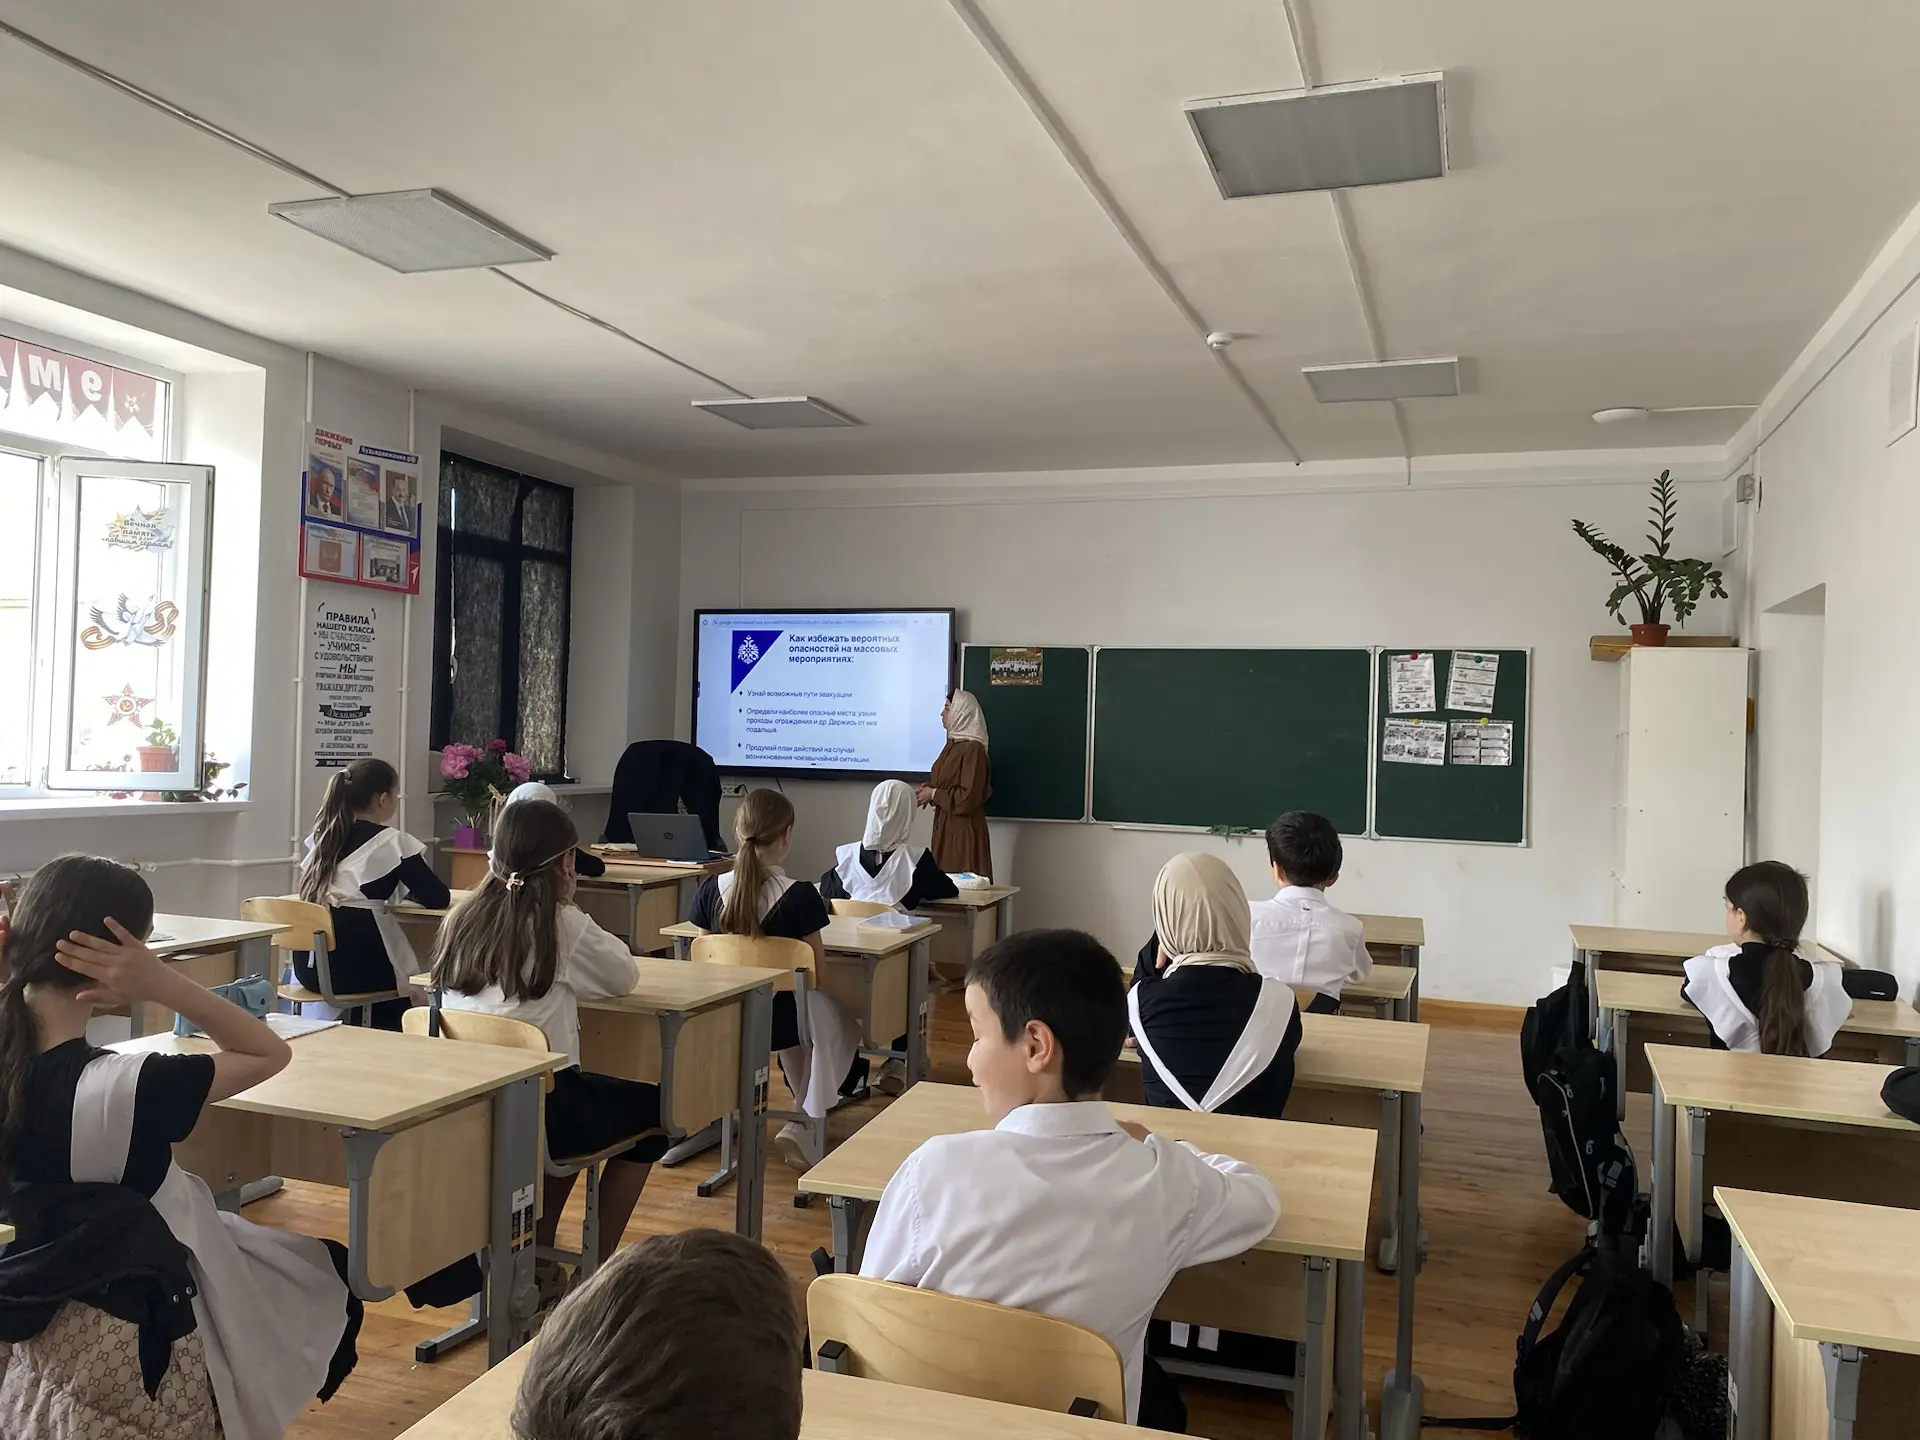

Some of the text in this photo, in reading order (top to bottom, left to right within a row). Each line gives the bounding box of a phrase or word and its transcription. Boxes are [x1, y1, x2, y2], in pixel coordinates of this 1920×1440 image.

[315, 437, 342, 451] ПЕРВЫХ
[124, 518, 156, 529] Вечная
[122, 529, 156, 537] память
[326, 612, 370, 625] ПРАВИЛА
[316, 622, 375, 634] НАШЕГО КЛАССА
[318, 630, 329, 639] МЫ
[789, 634, 900, 644] Как избежать вероятных
[327, 641, 360, 652] УЧИМСЯ
[789, 644, 840, 653] опасностей
[319, 652, 374, 663] УДОВОЛЬСТВИЕМ
[789, 655, 855, 664] мероприятиях:
[339, 663, 357, 674] МЫ
[747, 690, 766, 698] Узнай
[767, 690, 803, 698] возможные
[803, 691, 817, 699] пути
[746, 708, 778, 716] Определи
[828, 718, 857, 726] Держись
[745, 744, 777, 752] Продумай
[793, 745, 823, 753] действий
[832, 746, 855, 754] случай
